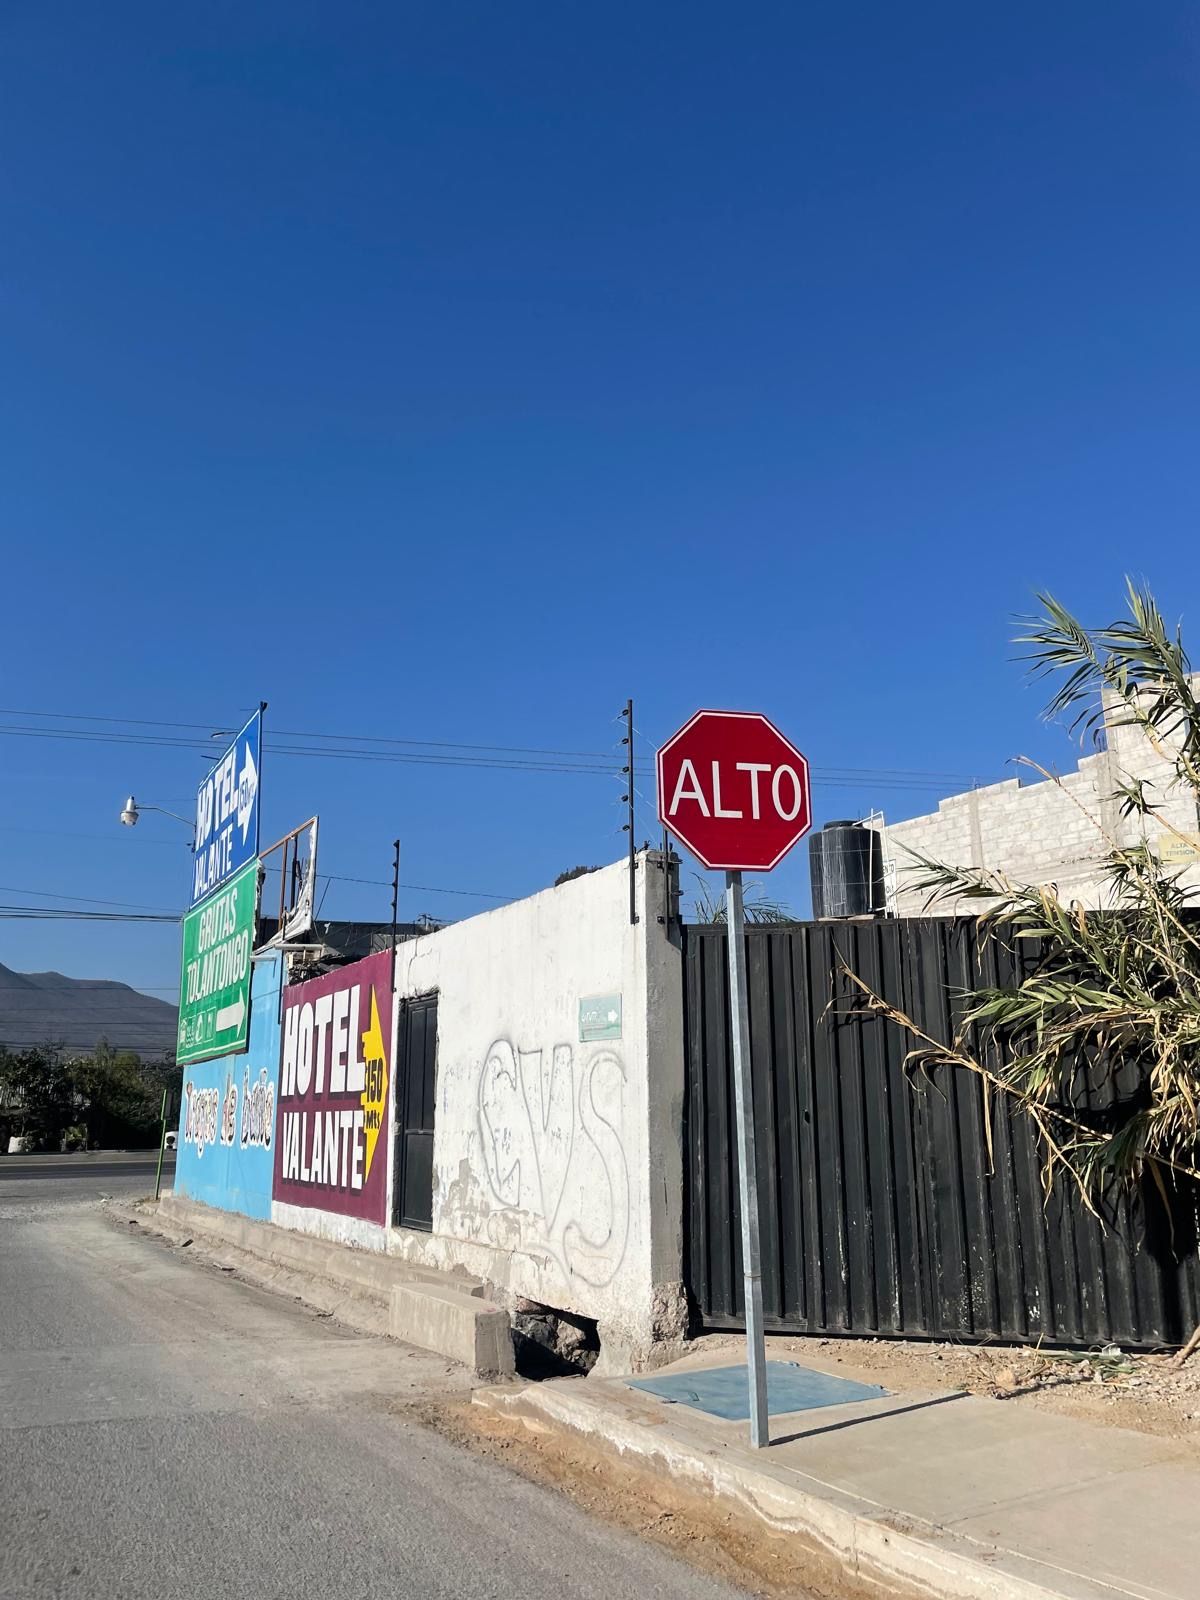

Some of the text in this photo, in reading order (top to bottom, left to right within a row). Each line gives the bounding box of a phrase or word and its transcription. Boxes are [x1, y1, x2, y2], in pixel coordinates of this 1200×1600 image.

[196, 746, 239, 851] HOTEL
[669, 759, 801, 821] ALTO
[194, 823, 233, 900] VALANTE
[198, 887, 238, 953] GRUTAS
[186, 928, 249, 1006] TOLANTONGO
[281, 984, 366, 1097] HOTEL
[220, 1072, 238, 1147] de
[366, 1057, 384, 1103] 150
[282, 1110, 365, 1190] VALANTE
